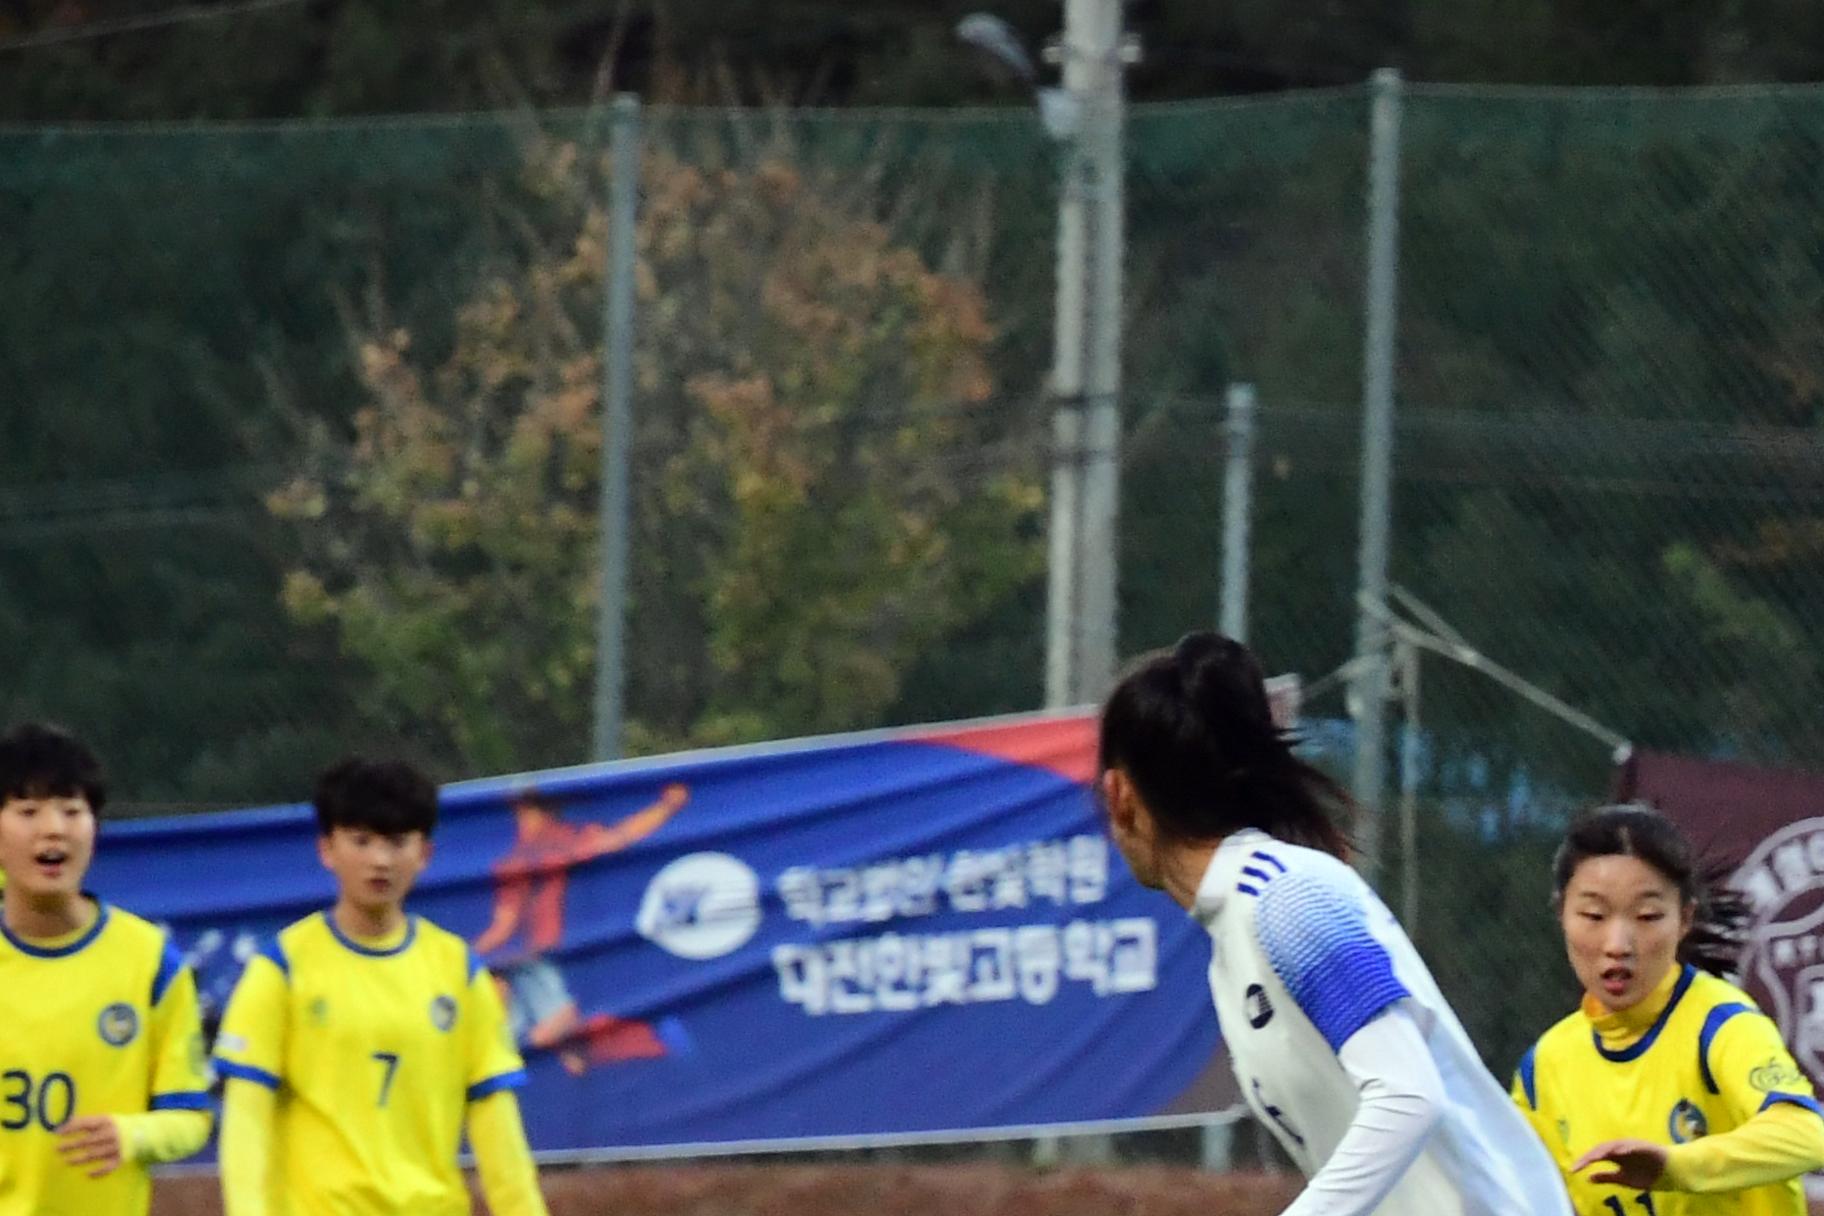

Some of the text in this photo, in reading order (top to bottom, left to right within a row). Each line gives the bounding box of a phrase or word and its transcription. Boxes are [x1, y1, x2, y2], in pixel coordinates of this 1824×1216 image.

[770, 916, 1158, 1016] 대전한빛고등학교
[0, 1069, 75, 1132] 30
[373, 1052, 397, 1107] 7
